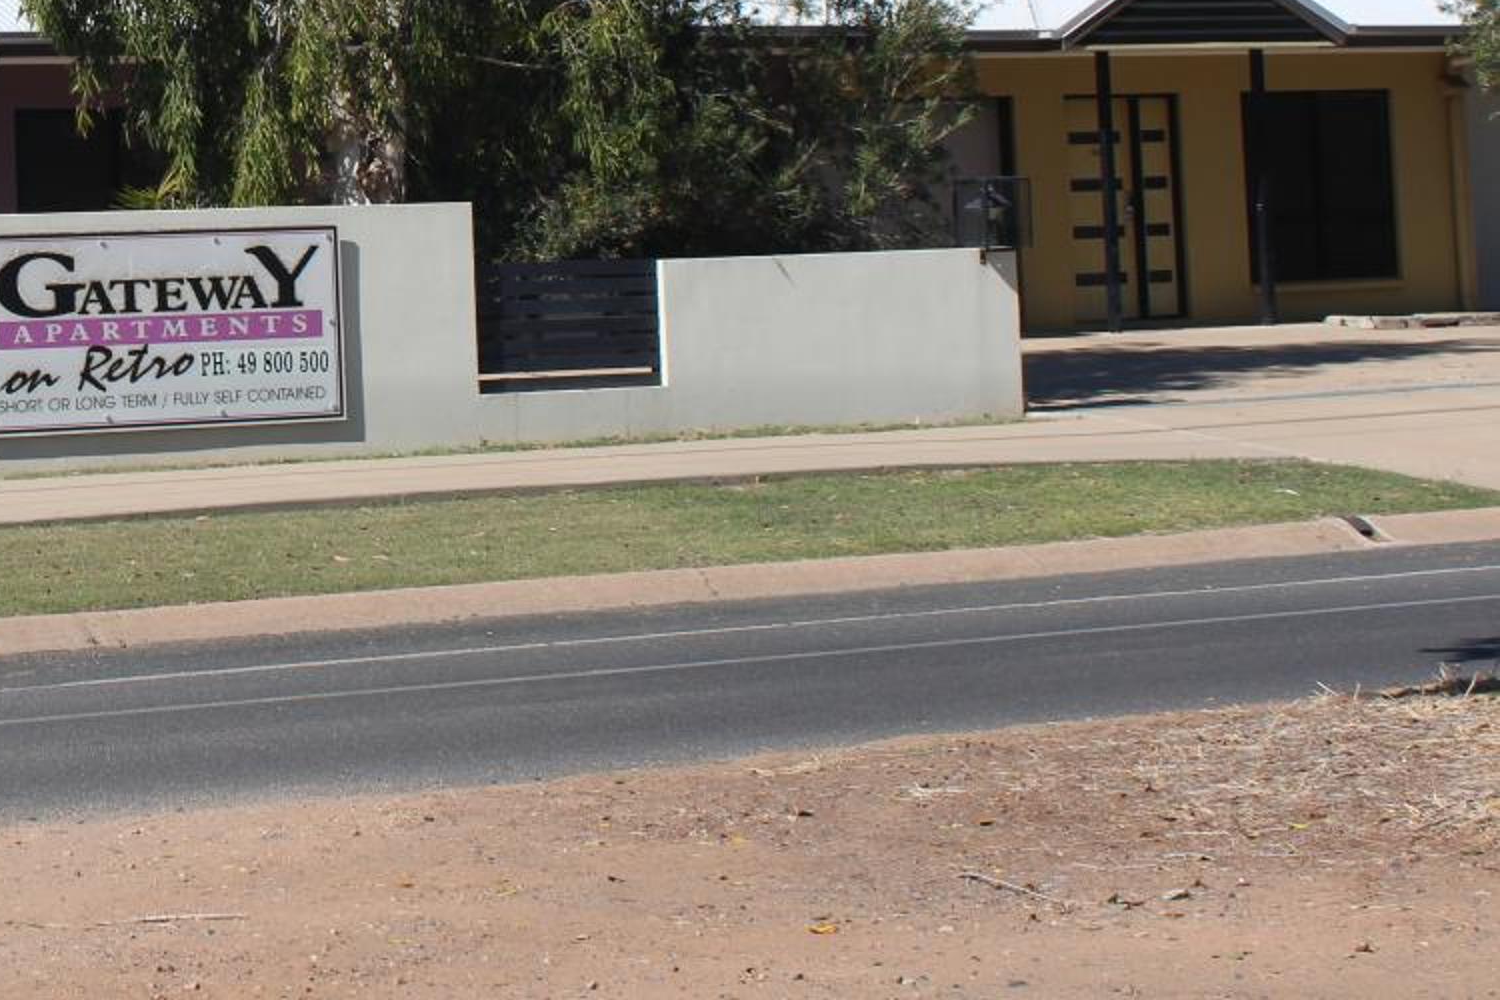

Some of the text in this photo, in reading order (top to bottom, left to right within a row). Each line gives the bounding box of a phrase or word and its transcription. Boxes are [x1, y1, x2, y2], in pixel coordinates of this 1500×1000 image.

[14, 313, 310, 345] APARTMENTS
[0, 344, 195, 394] on Retro
[200, 350, 329, 376] PH: 49 800 500
[0, 398, 43, 413] SHORT
[48, 397, 70, 411] OR
[75, 395, 116, 411] LONG
[122, 394, 157, 408] TERM
[173, 391, 210, 406] FULLY
[214, 389, 244, 404] SELF
[247, 385, 326, 403] CONTAINED
